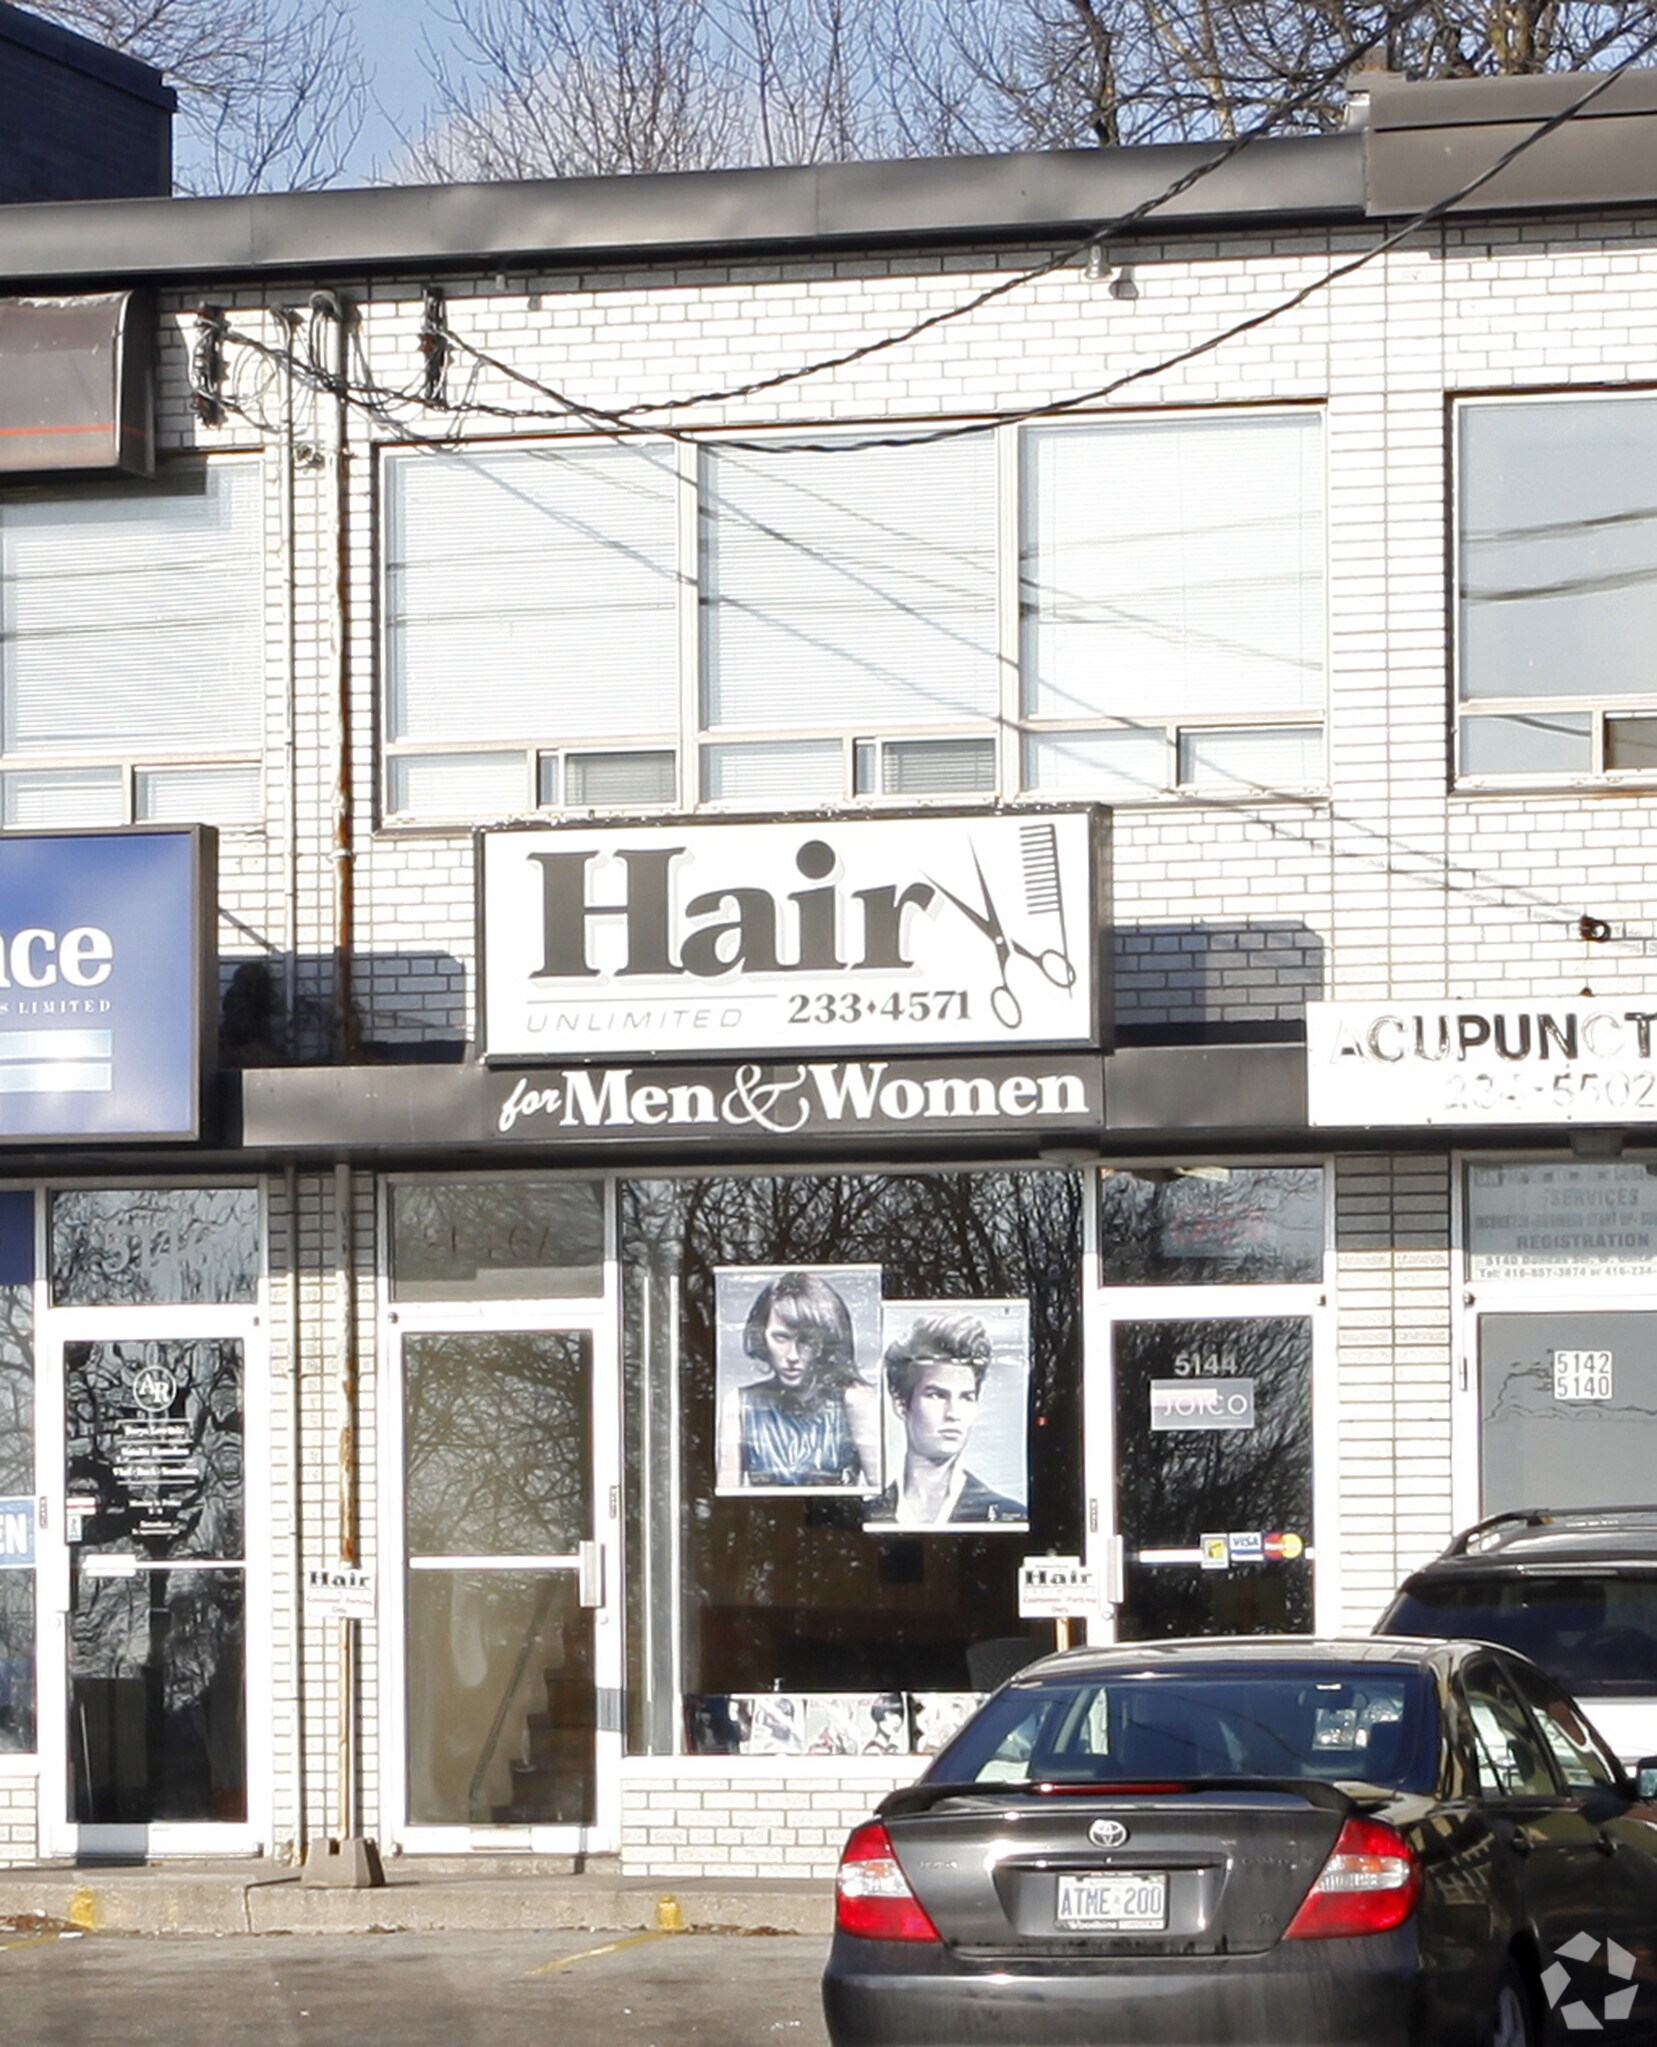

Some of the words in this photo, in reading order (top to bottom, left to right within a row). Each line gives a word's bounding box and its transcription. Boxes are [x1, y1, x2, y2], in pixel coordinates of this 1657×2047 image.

[526, 839, 937, 978] Hair
[18, 999, 112, 1015] LIMITED
[526, 1008, 743, 1033] UNLIMITED
[499, 1077, 562, 1132] for
[558, 1068, 718, 1127] Men
[720, 1063, 810, 1137] &
[806, 1062, 1091, 1120] Women
[1550, 1188, 1639, 1207] SERVICES
[1516, 1232, 1649, 1250] REGISTRATION
[1174, 1353, 1238, 1375] 5144
[1557, 1352, 1610, 1374] 5142
[1557, 1375, 1610, 1397] 5140
[1232, 1535, 1259, 1547] VISA
[309, 1570, 371, 1587] Hair
[1024, 1569, 1093, 1585] Hair
[1060, 1887, 1111, 1916] ATME
[1123, 1886, 1163, 1915] 200
